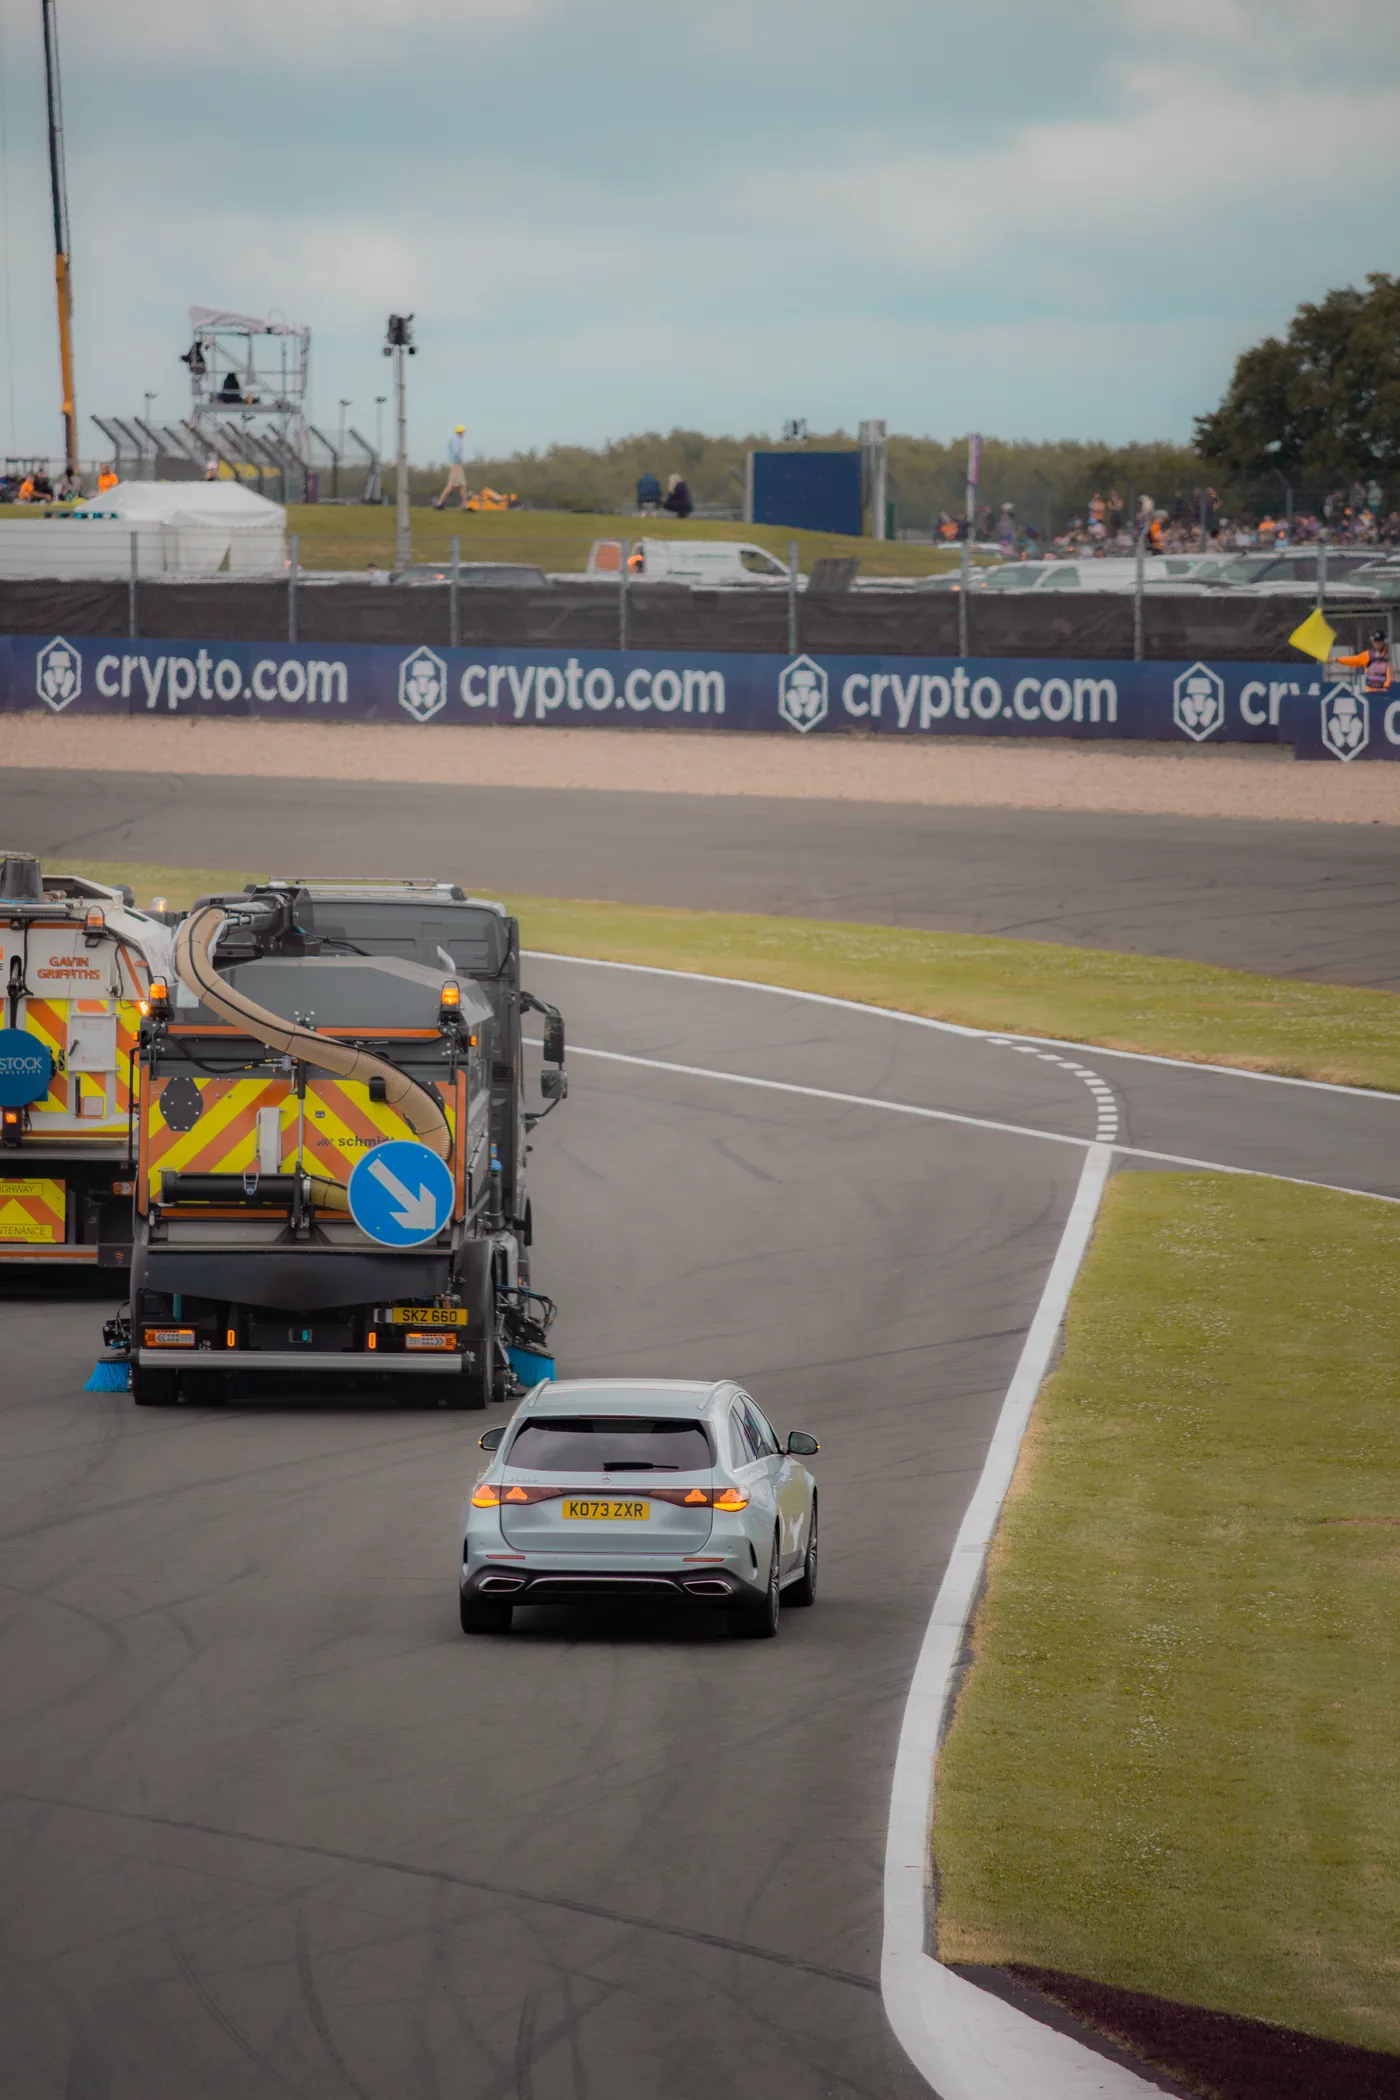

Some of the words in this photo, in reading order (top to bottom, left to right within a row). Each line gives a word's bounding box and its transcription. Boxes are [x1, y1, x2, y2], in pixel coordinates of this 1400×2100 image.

[95, 648, 348, 709] crypto.com
[460, 657, 725, 719] crypto.com
[841, 666, 1118, 729] crypto.com
[49, 956, 89, 967] GAVIN
[37, 968, 101, 979] GRIFFITHS
[402, 1309, 428, 1322] SKZ
[431, 1310, 458, 1323] 660
[569, 1502, 609, 1517] KO73
[613, 1503, 644, 1518] ZXR
